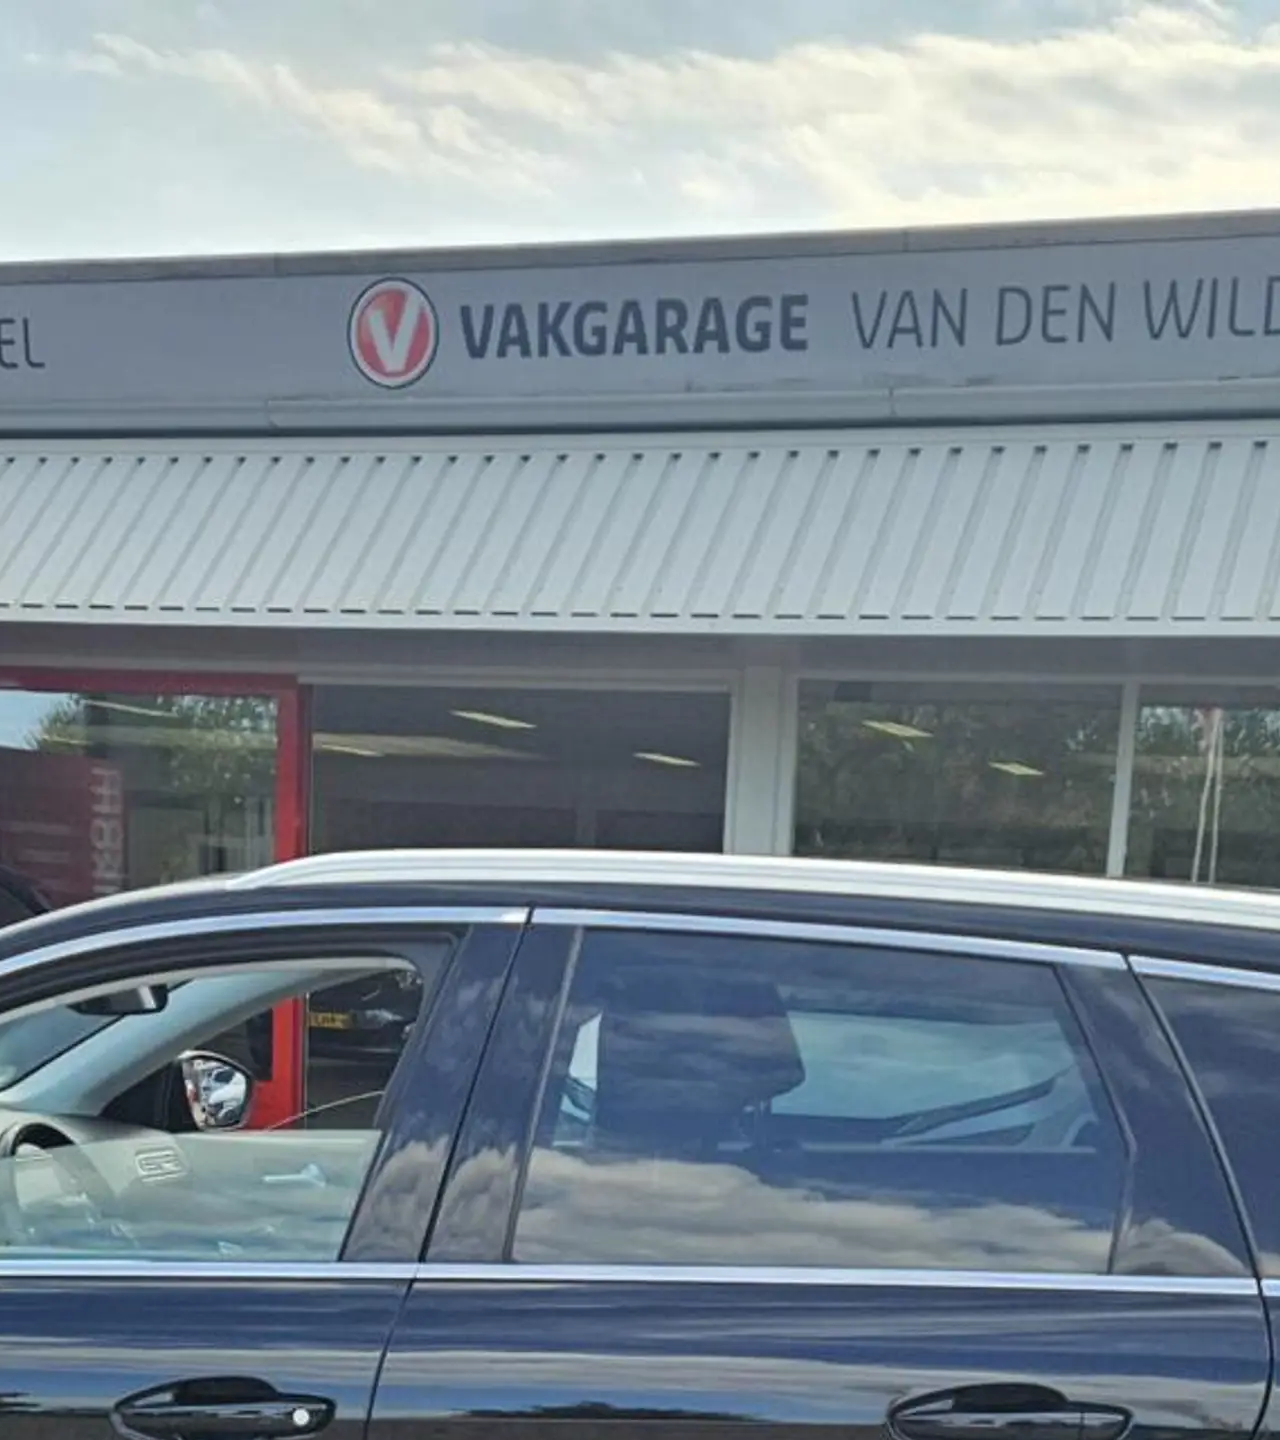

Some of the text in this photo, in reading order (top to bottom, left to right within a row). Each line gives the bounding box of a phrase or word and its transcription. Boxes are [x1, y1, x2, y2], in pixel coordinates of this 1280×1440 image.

[459, 294, 809, 360] VAKGARAGE
[850, 288, 968, 350] VAN
[995, 280, 1117, 347] DEN
